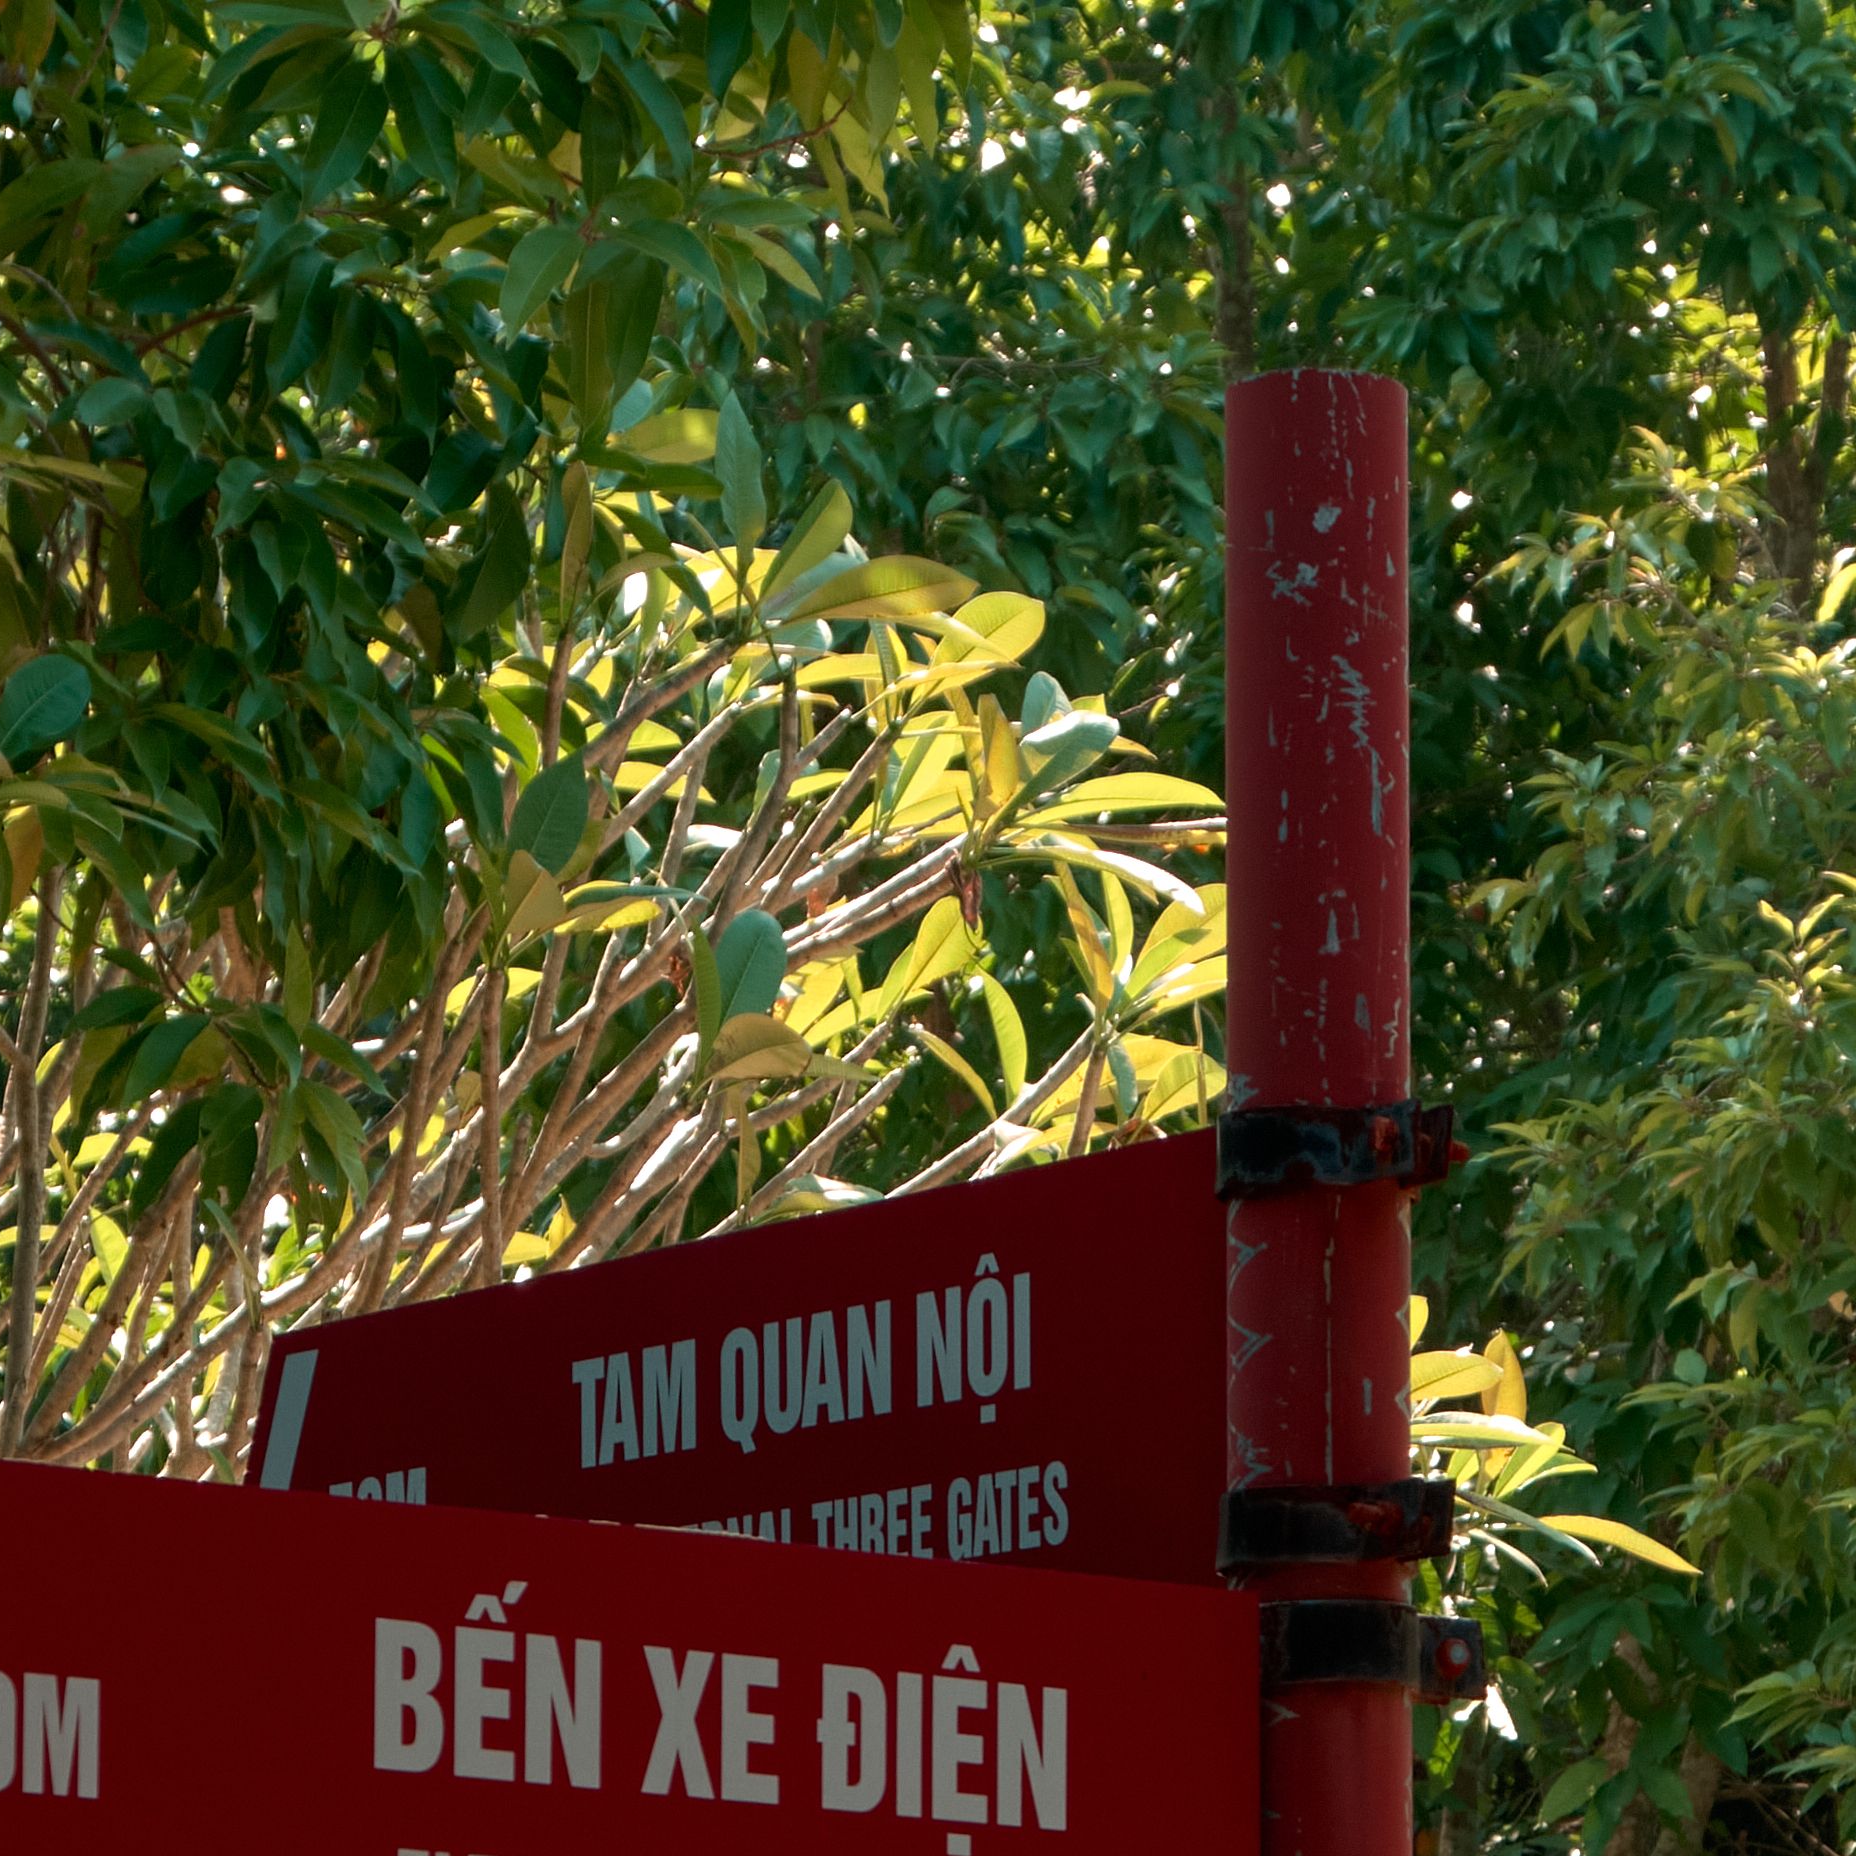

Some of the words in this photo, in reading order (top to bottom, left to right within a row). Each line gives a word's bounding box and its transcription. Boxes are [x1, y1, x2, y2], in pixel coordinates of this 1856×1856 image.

[573, 1339, 696, 1467] TAM
[721, 1300, 891, 1453] QUAN
[917, 1253, 1030, 1423] NỘI
[812, 1484, 932, 1558] THREE
[948, 1462, 1068, 1561] GATES
[375, 1582, 600, 1788] BẾN
[642, 1646, 778, 1804] XE
[818, 1645, 1066, 1856] ĐIỆN
